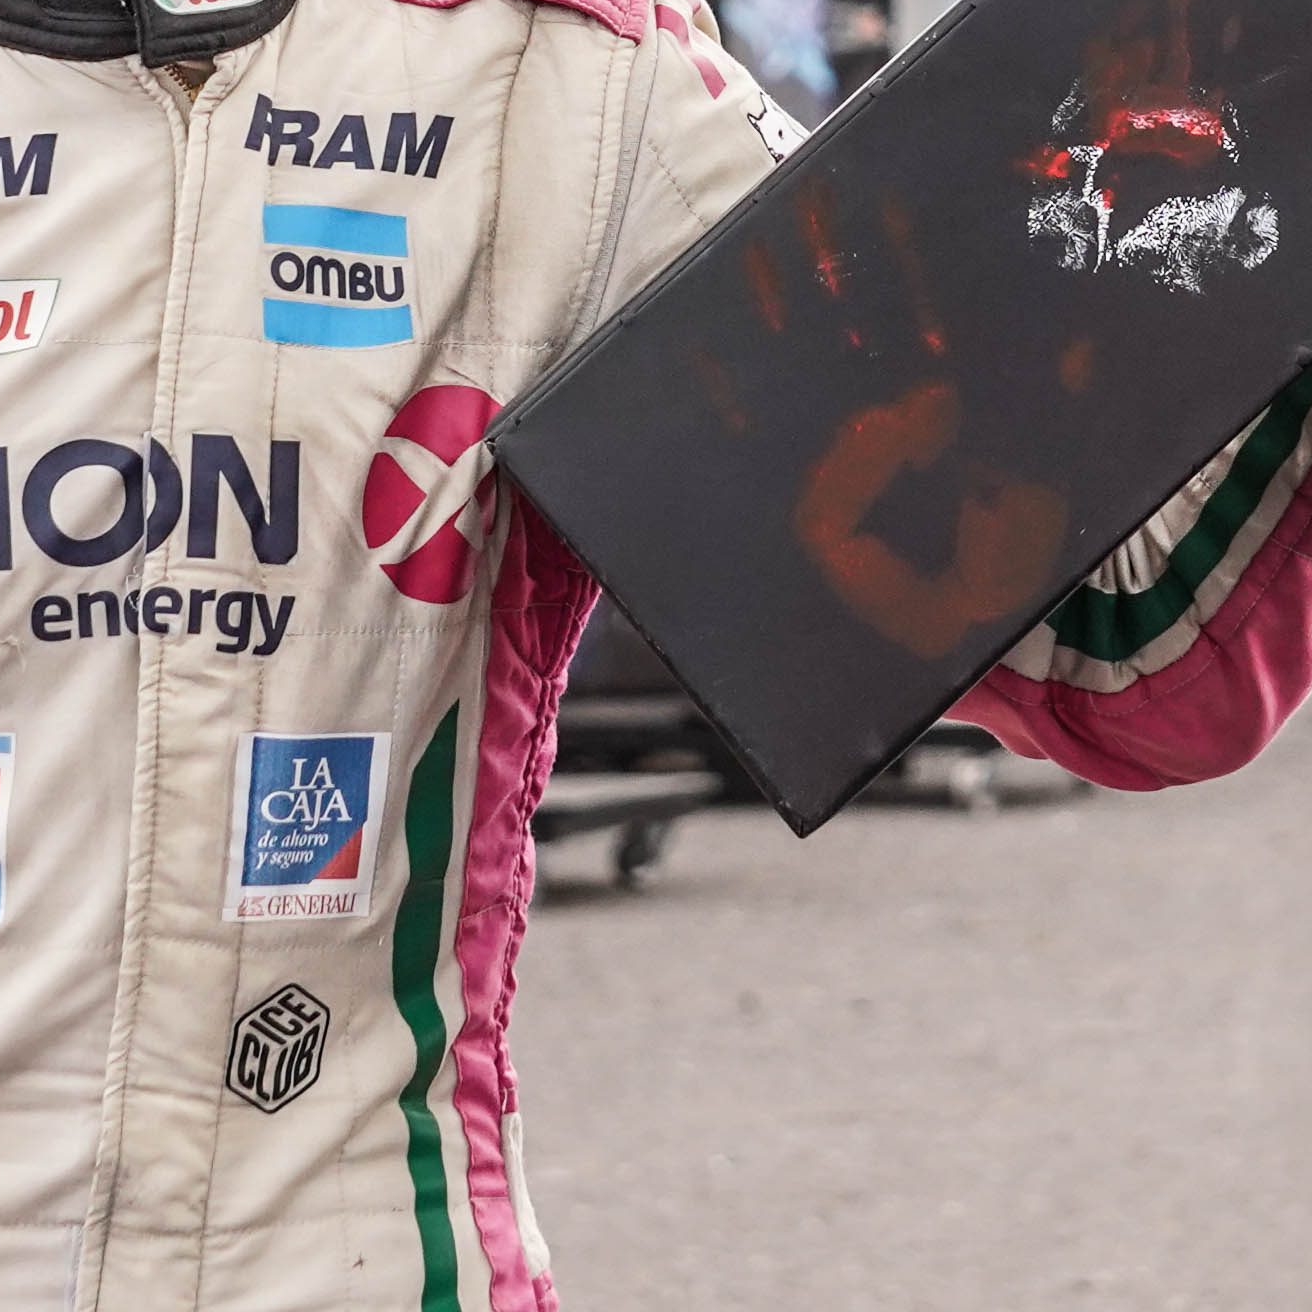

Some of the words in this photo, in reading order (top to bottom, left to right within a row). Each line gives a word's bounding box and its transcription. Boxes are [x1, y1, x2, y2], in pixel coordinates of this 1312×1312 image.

[31, 584, 296, 657] energy
[289, 757, 336, 791] LA
[261, 788, 353, 831] CAJA
[257, 830, 276, 849] de
[281, 829, 329, 848] ahorro
[255, 852, 268, 870] y
[270, 850, 314, 869] seguro
[267, 893, 358, 917] GENERALI
[249, 992, 321, 1045] ICE
[238, 1024, 320, 1103] CLUB
